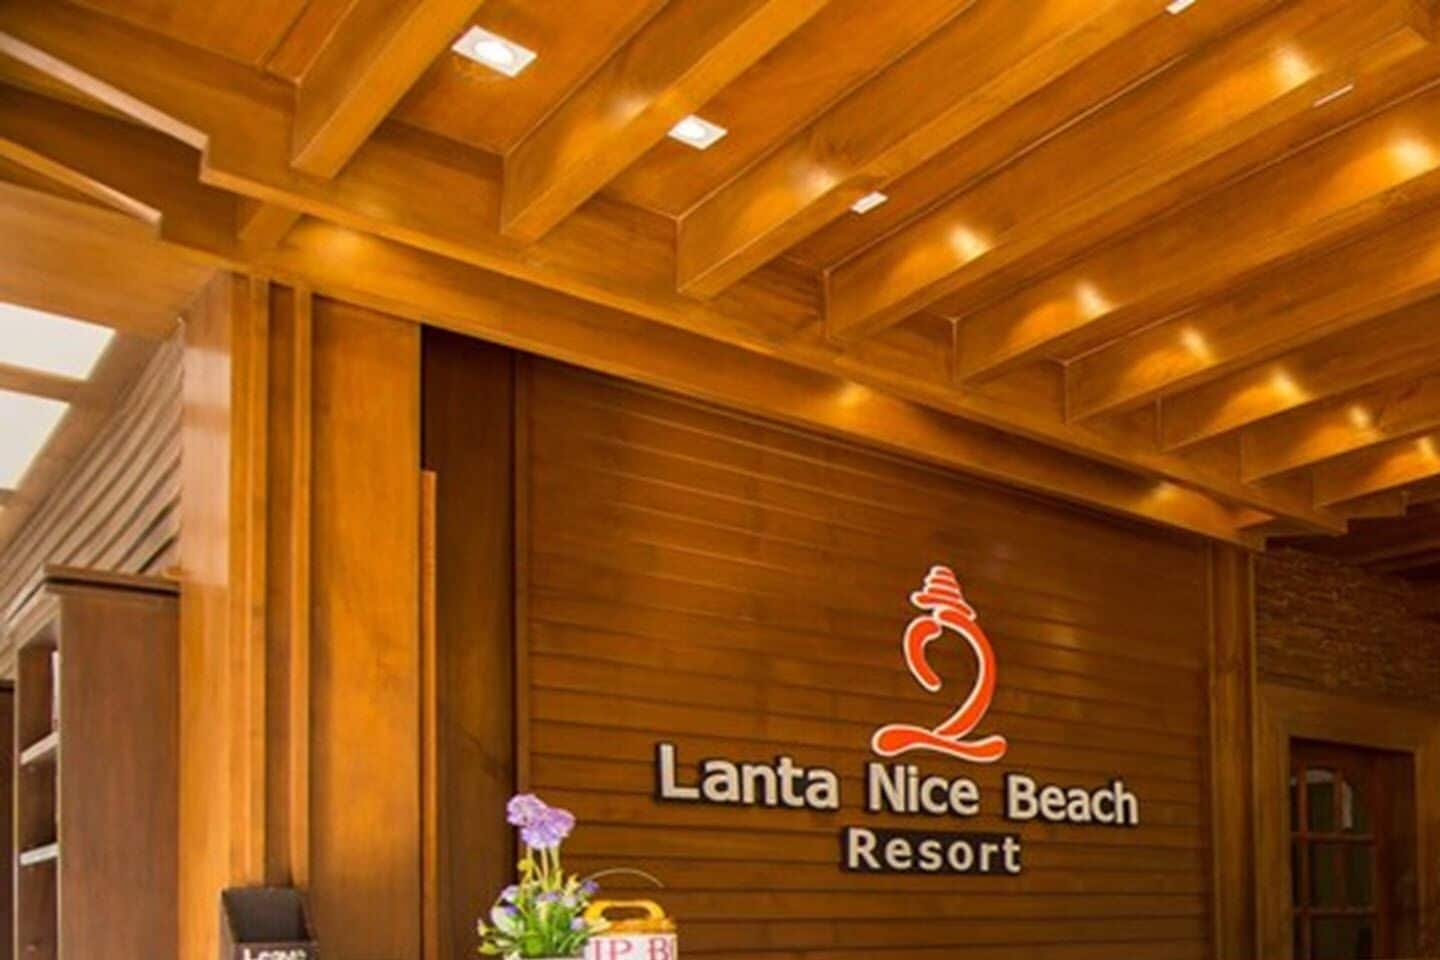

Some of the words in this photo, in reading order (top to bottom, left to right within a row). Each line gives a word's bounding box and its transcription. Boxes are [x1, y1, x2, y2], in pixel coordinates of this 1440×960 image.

[657, 744, 840, 810] Lanta
[868, 763, 981, 815] Nice
[1006, 775, 1139, 825] Beach
[846, 828, 1021, 874] Resort
